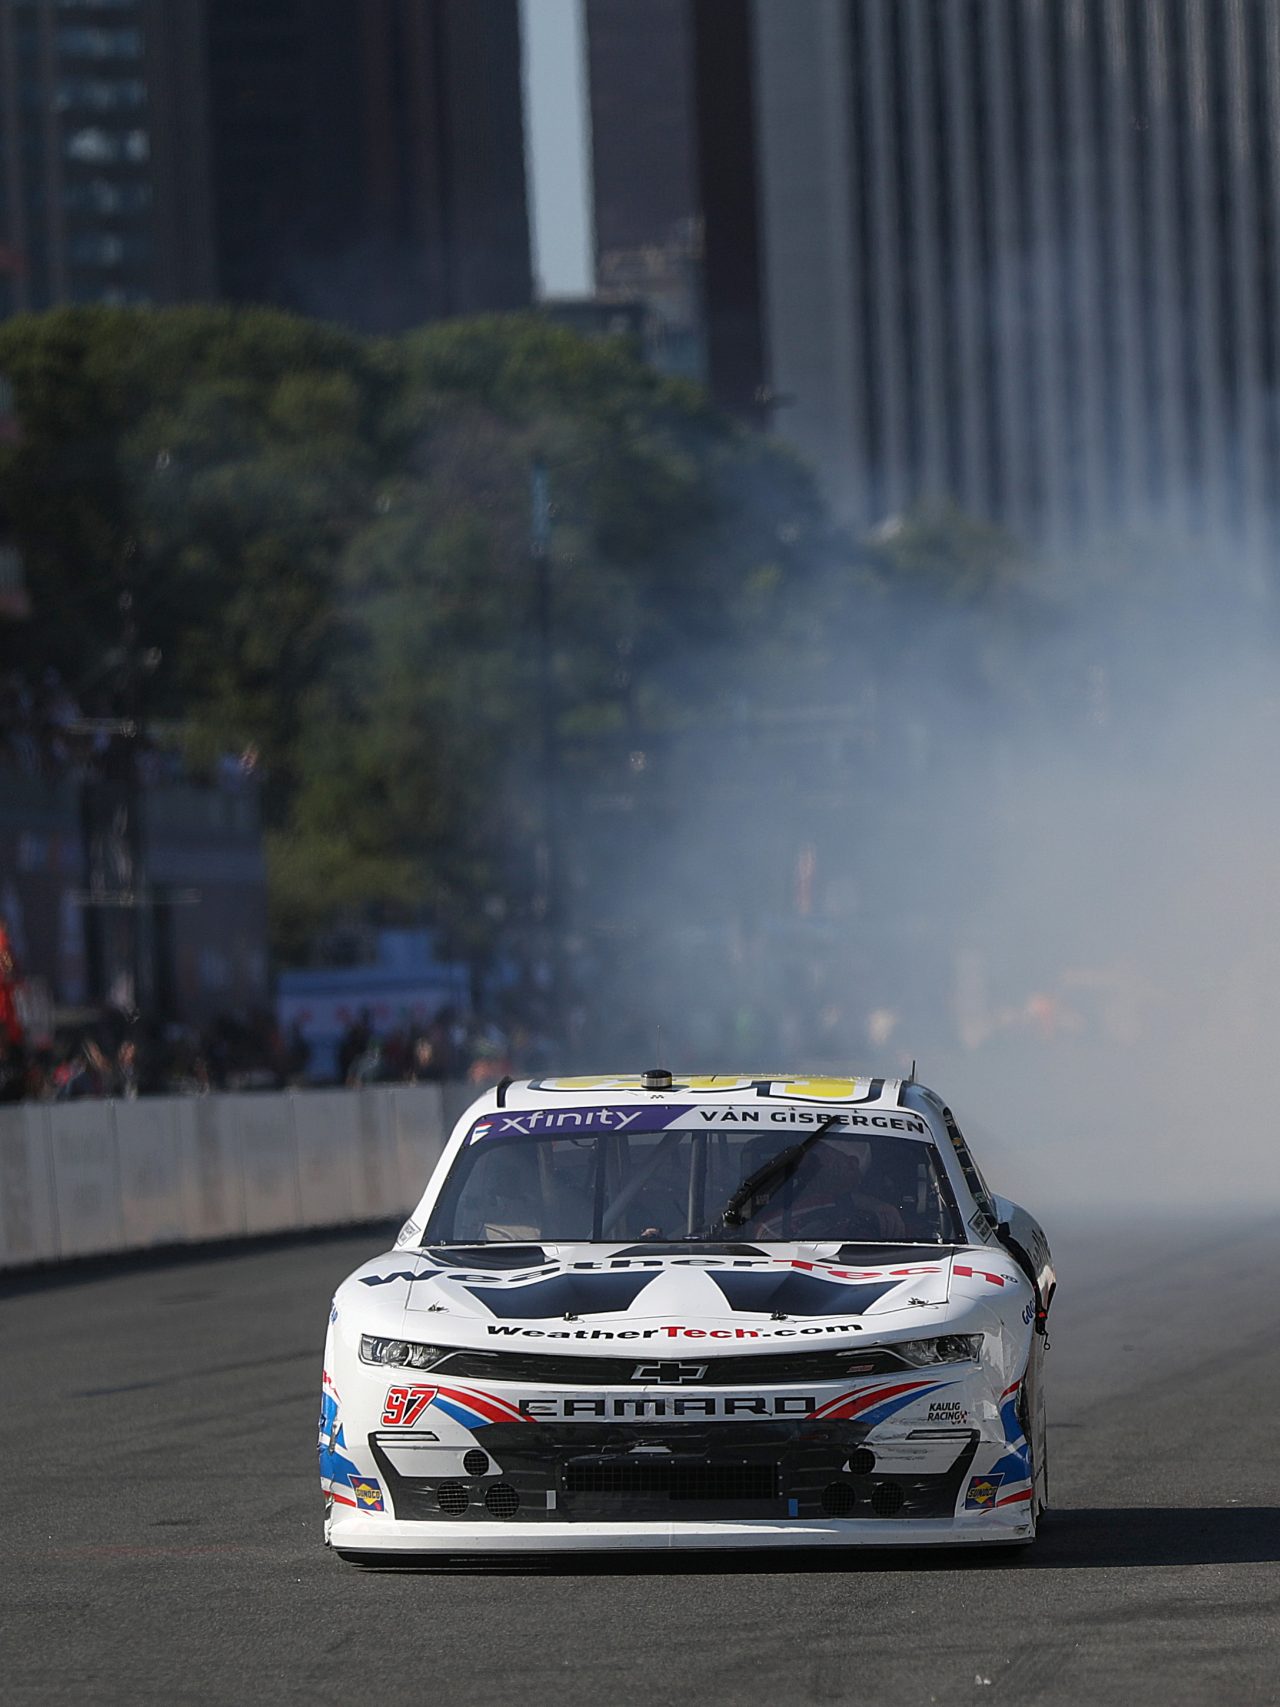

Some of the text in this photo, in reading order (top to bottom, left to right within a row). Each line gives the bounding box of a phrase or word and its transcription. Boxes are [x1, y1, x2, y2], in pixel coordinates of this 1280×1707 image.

[499, 1108, 642, 1134] xfinity
[700, 1110, 925, 1134] VAN GISBERGEN
[381, 1385, 439, 1427] 97
[518, 1396, 816, 1417] CAMARO
[929, 1402, 961, 1411] KAULIG
[927, 1410, 961, 1421] RACING
[355, 1488, 381, 1500] SUNOCO
[968, 1486, 998, 1498] SUNOCO
